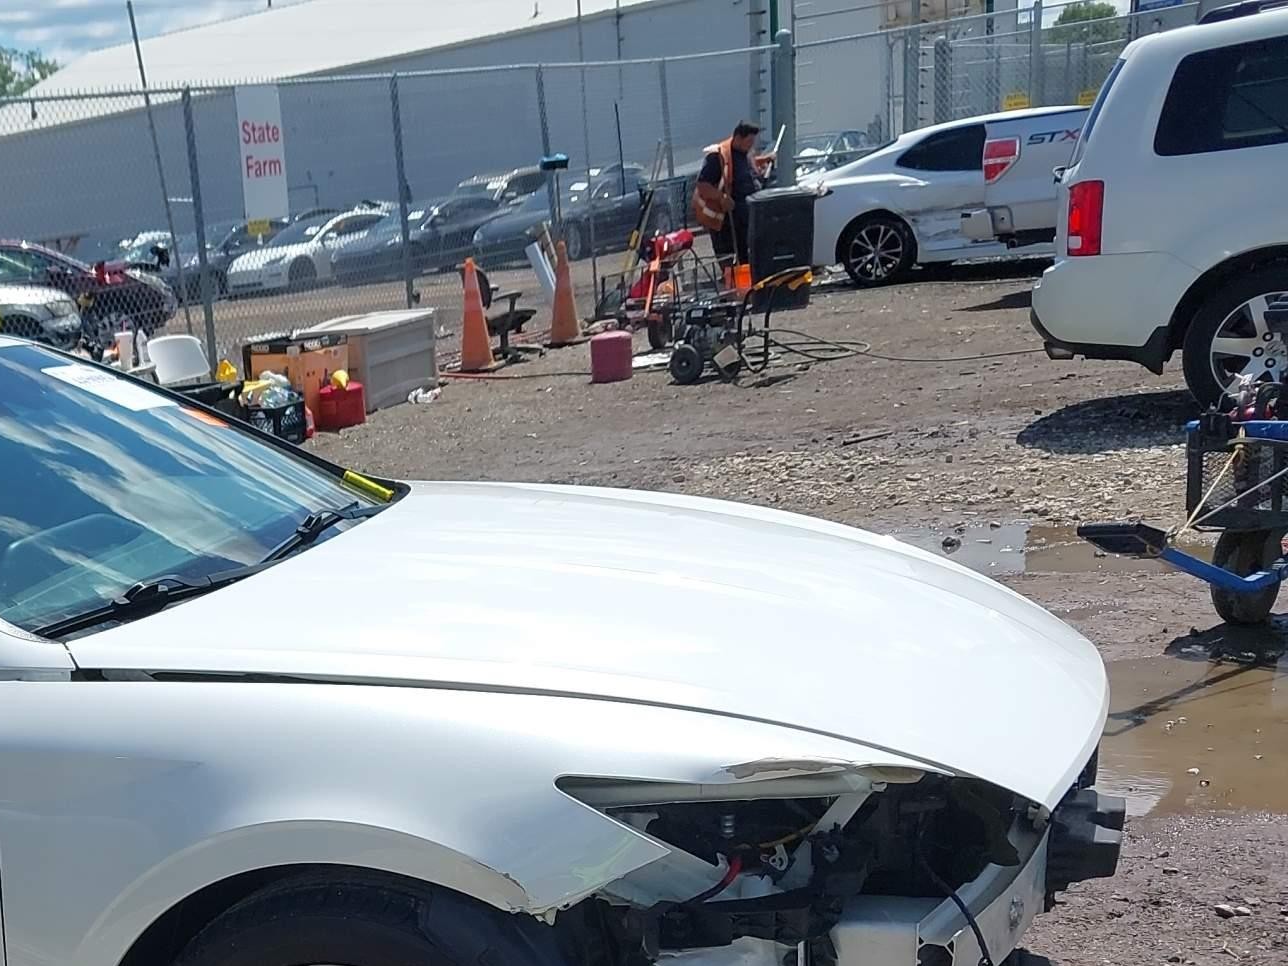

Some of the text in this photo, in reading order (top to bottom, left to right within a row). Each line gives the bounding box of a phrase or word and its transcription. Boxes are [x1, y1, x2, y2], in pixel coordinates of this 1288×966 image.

[242, 120, 280, 145] State
[1027, 128, 1080, 145] STX
[246, 155, 283, 178] Farm
